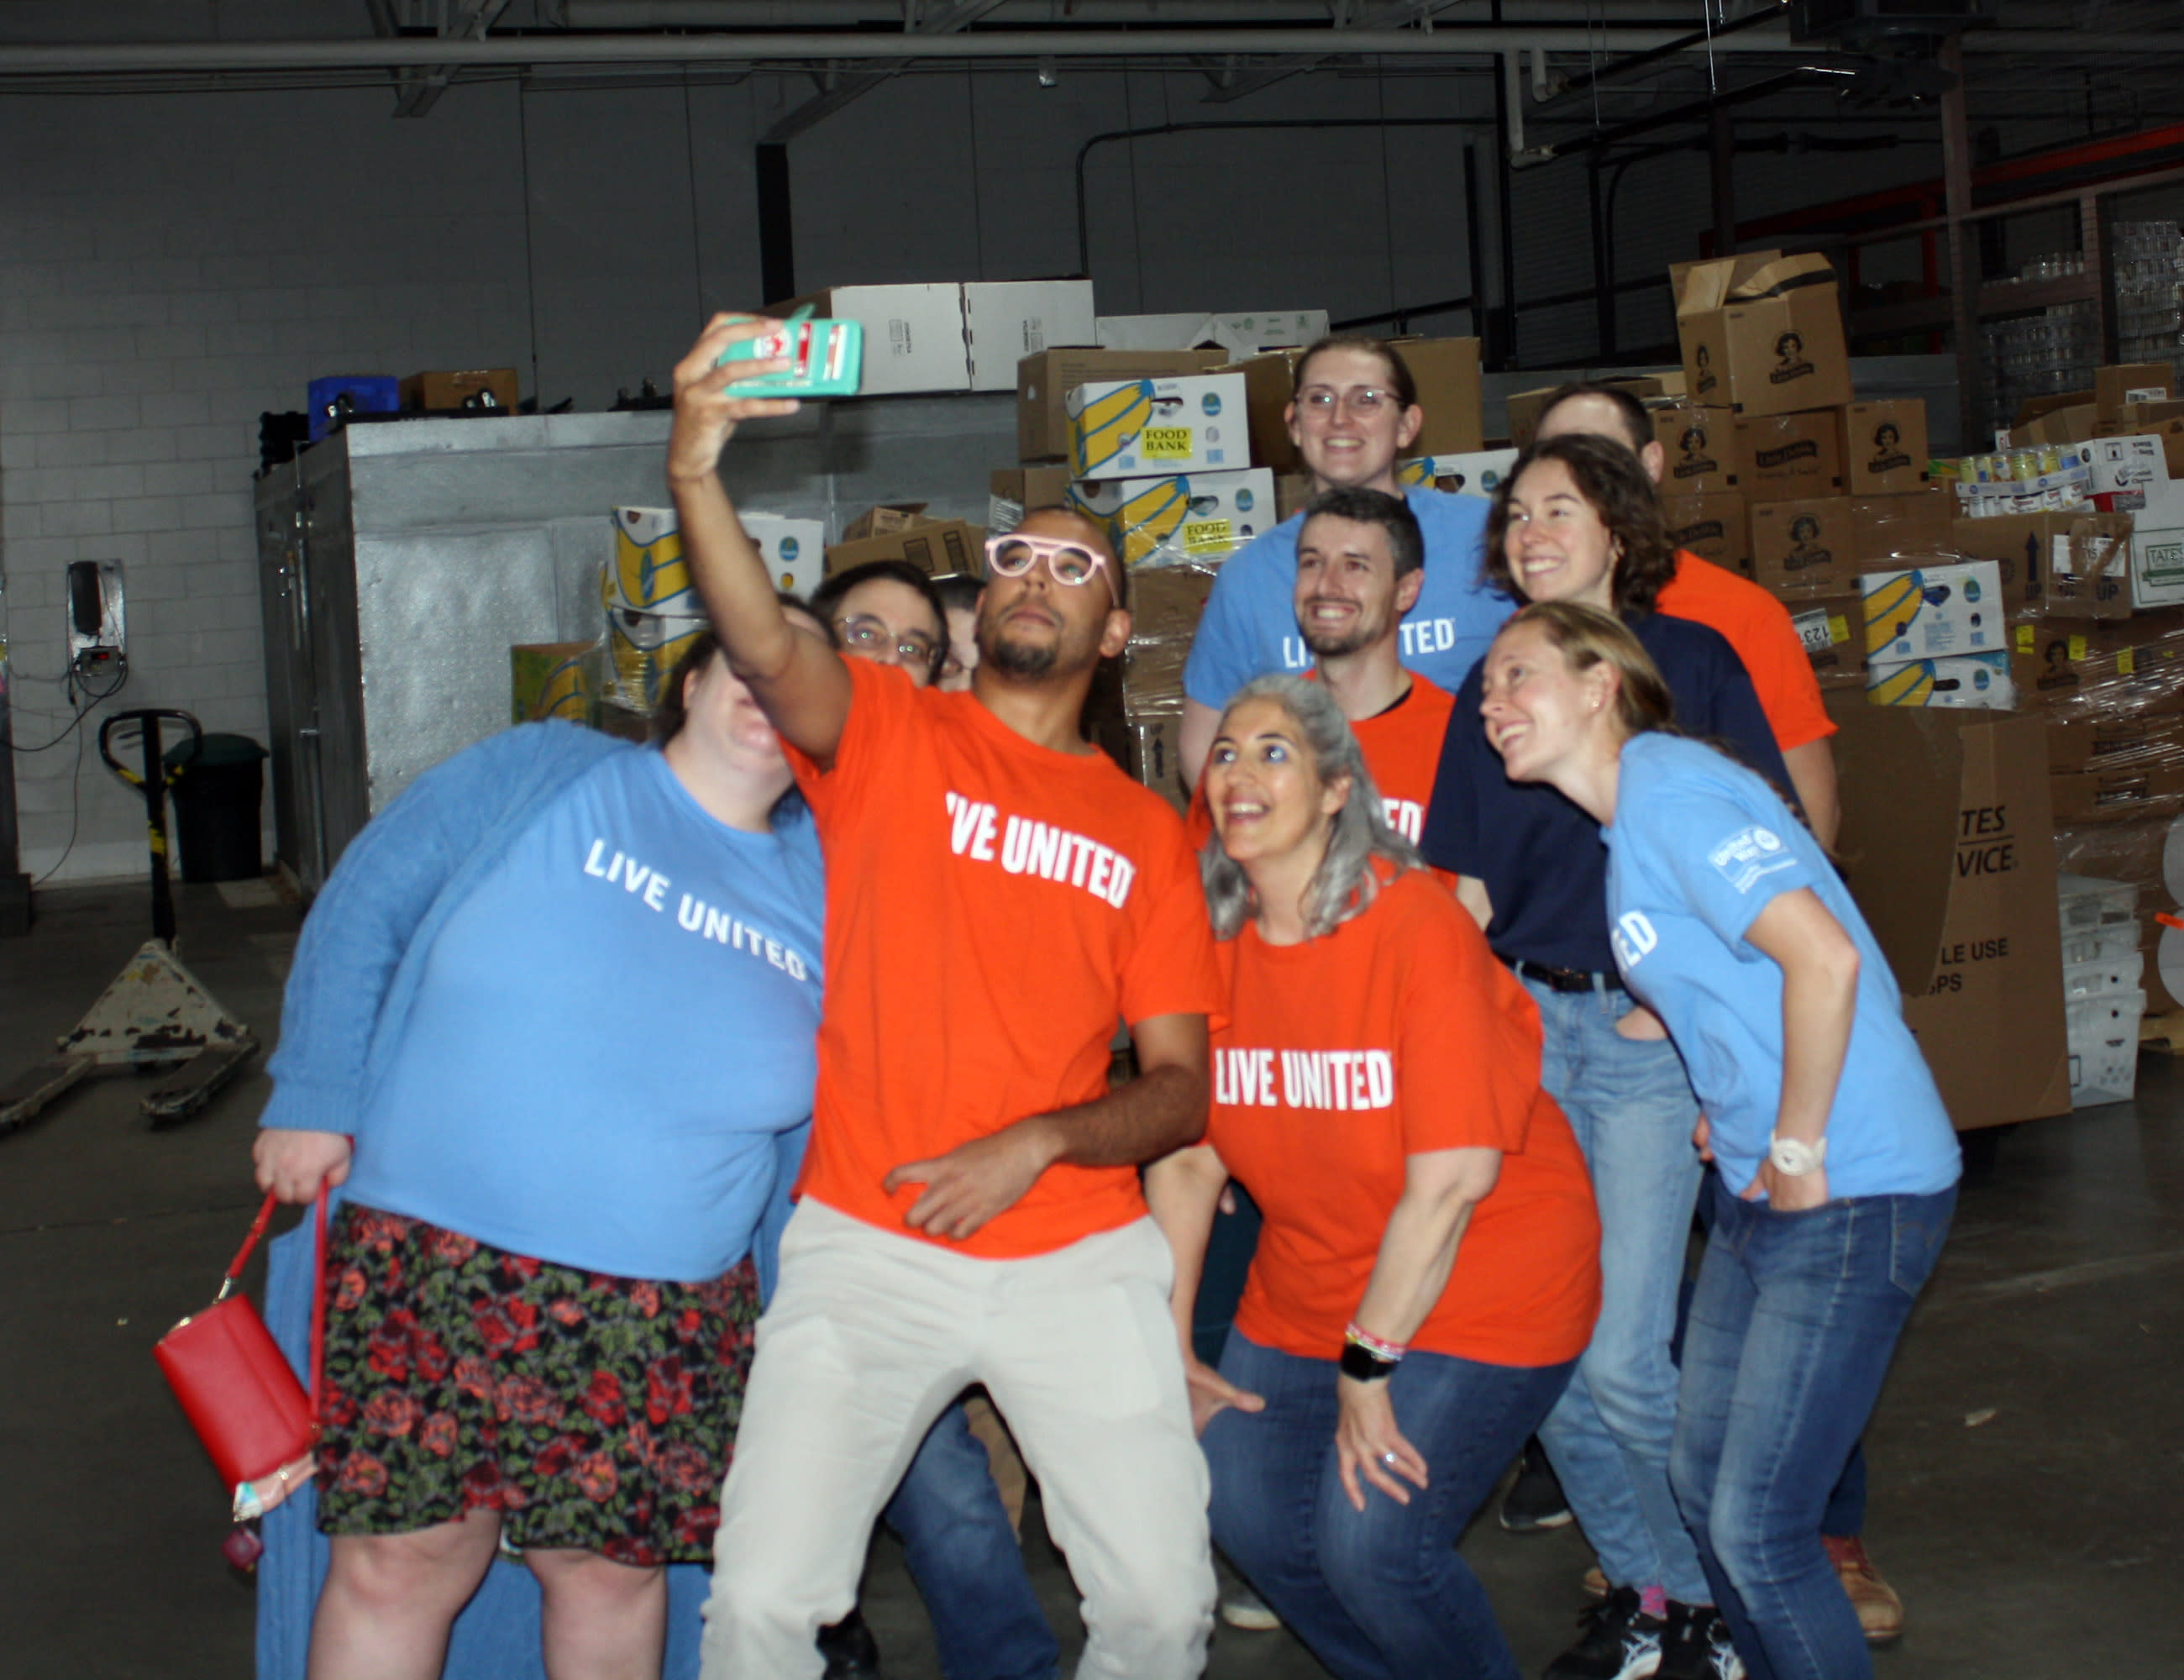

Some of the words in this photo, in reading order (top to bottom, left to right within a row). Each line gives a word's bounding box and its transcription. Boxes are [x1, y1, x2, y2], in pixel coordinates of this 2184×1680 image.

[1146, 429, 1187, 439] FOOD
[1146, 441, 1187, 451] BANK
[2097, 584, 2119, 600] UP
[1283, 636, 1315, 669] LI
[1399, 618, 1454, 656] TED
[1799, 626, 1830, 644] 123
[1382, 798, 1422, 846] ED
[1961, 806, 2006, 837] TES
[1000, 815, 1135, 909] UNITED
[1956, 844, 2013, 878] VICE
[584, 838, 671, 912] LIVE
[677, 893, 807, 981] UNITED
[1612, 910, 1658, 971] ED
[1941, 943, 1965, 965] LE
[1971, 937, 2009, 960] USE
[1215, 1048, 1277, 1106] LIVE
[1281, 1049, 1394, 1110] UNITED
